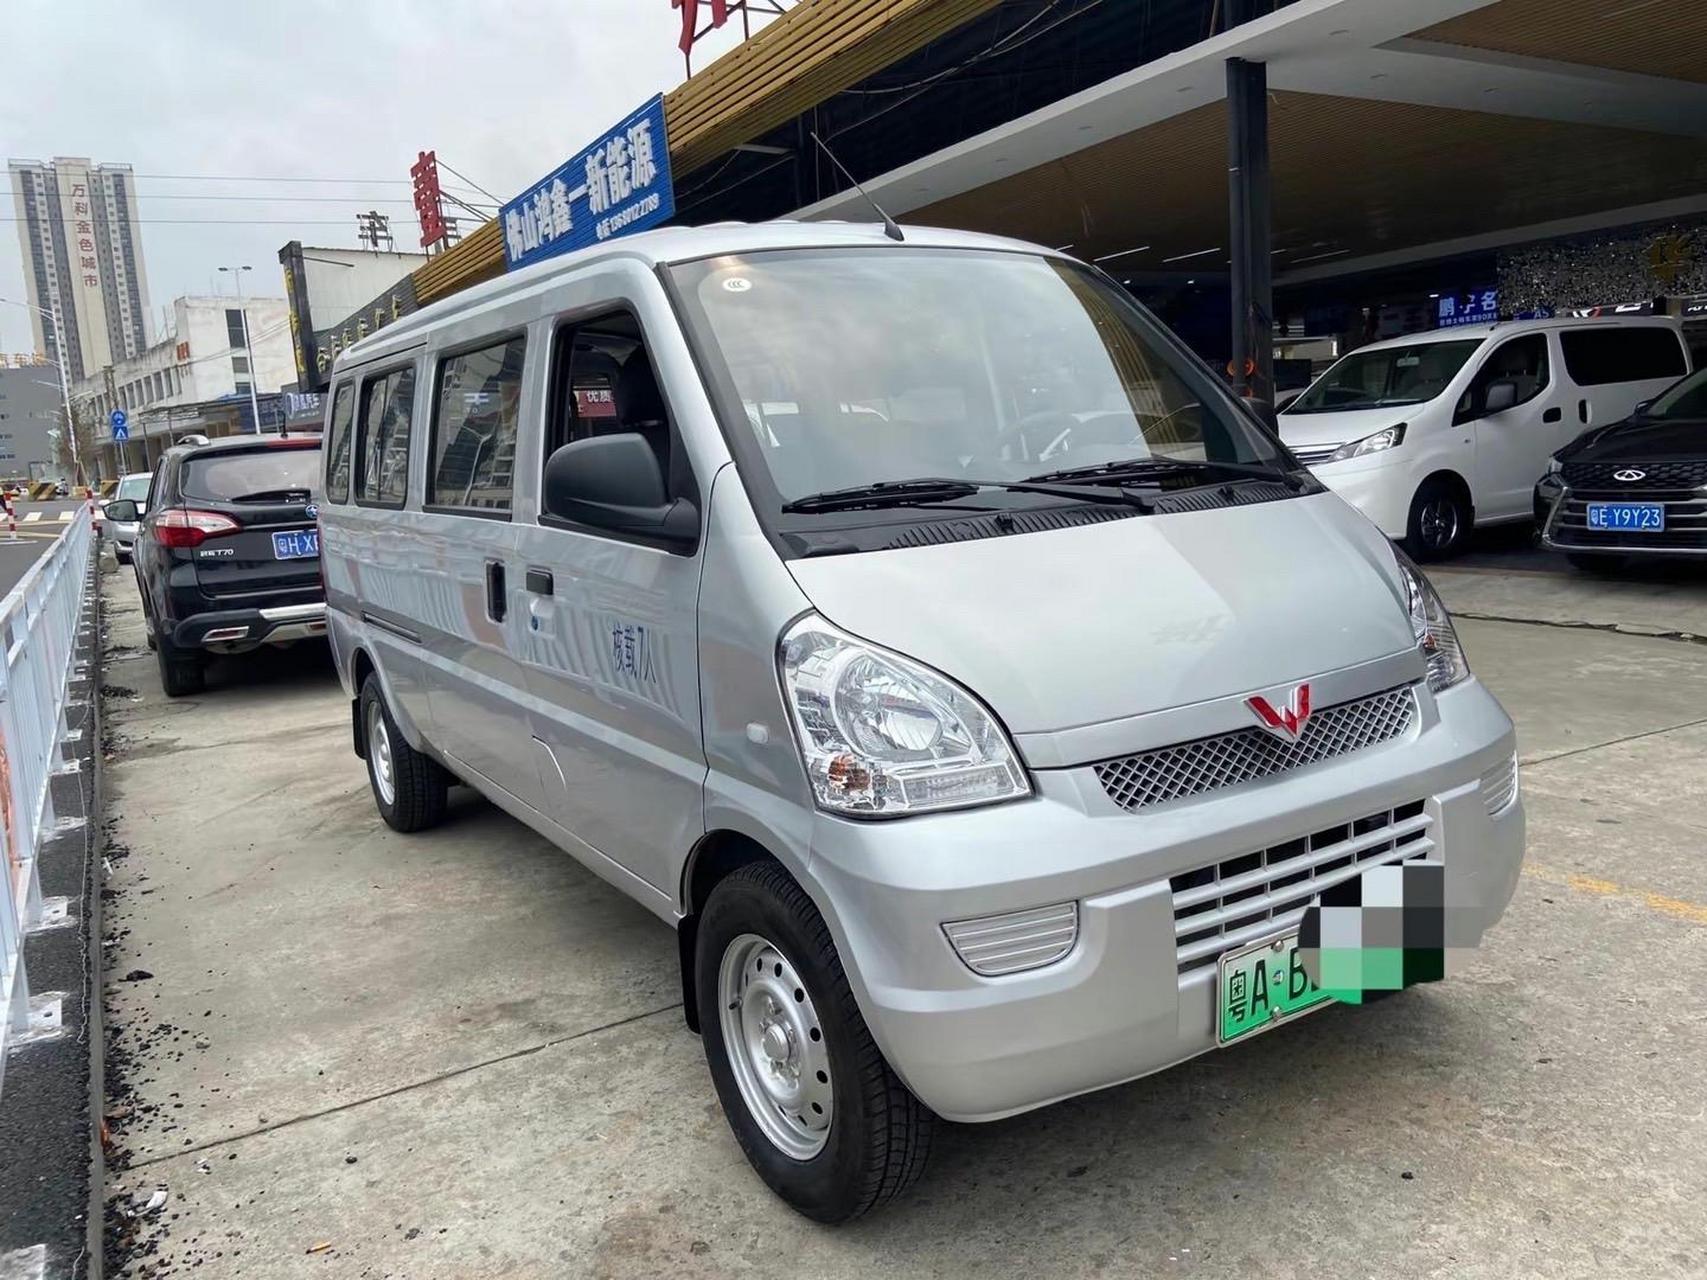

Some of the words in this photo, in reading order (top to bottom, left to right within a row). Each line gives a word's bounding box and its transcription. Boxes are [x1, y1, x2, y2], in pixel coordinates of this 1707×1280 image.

[72, 183, 98, 288] 万科金色城市
[612, 622, 657, 684] 核载7人
